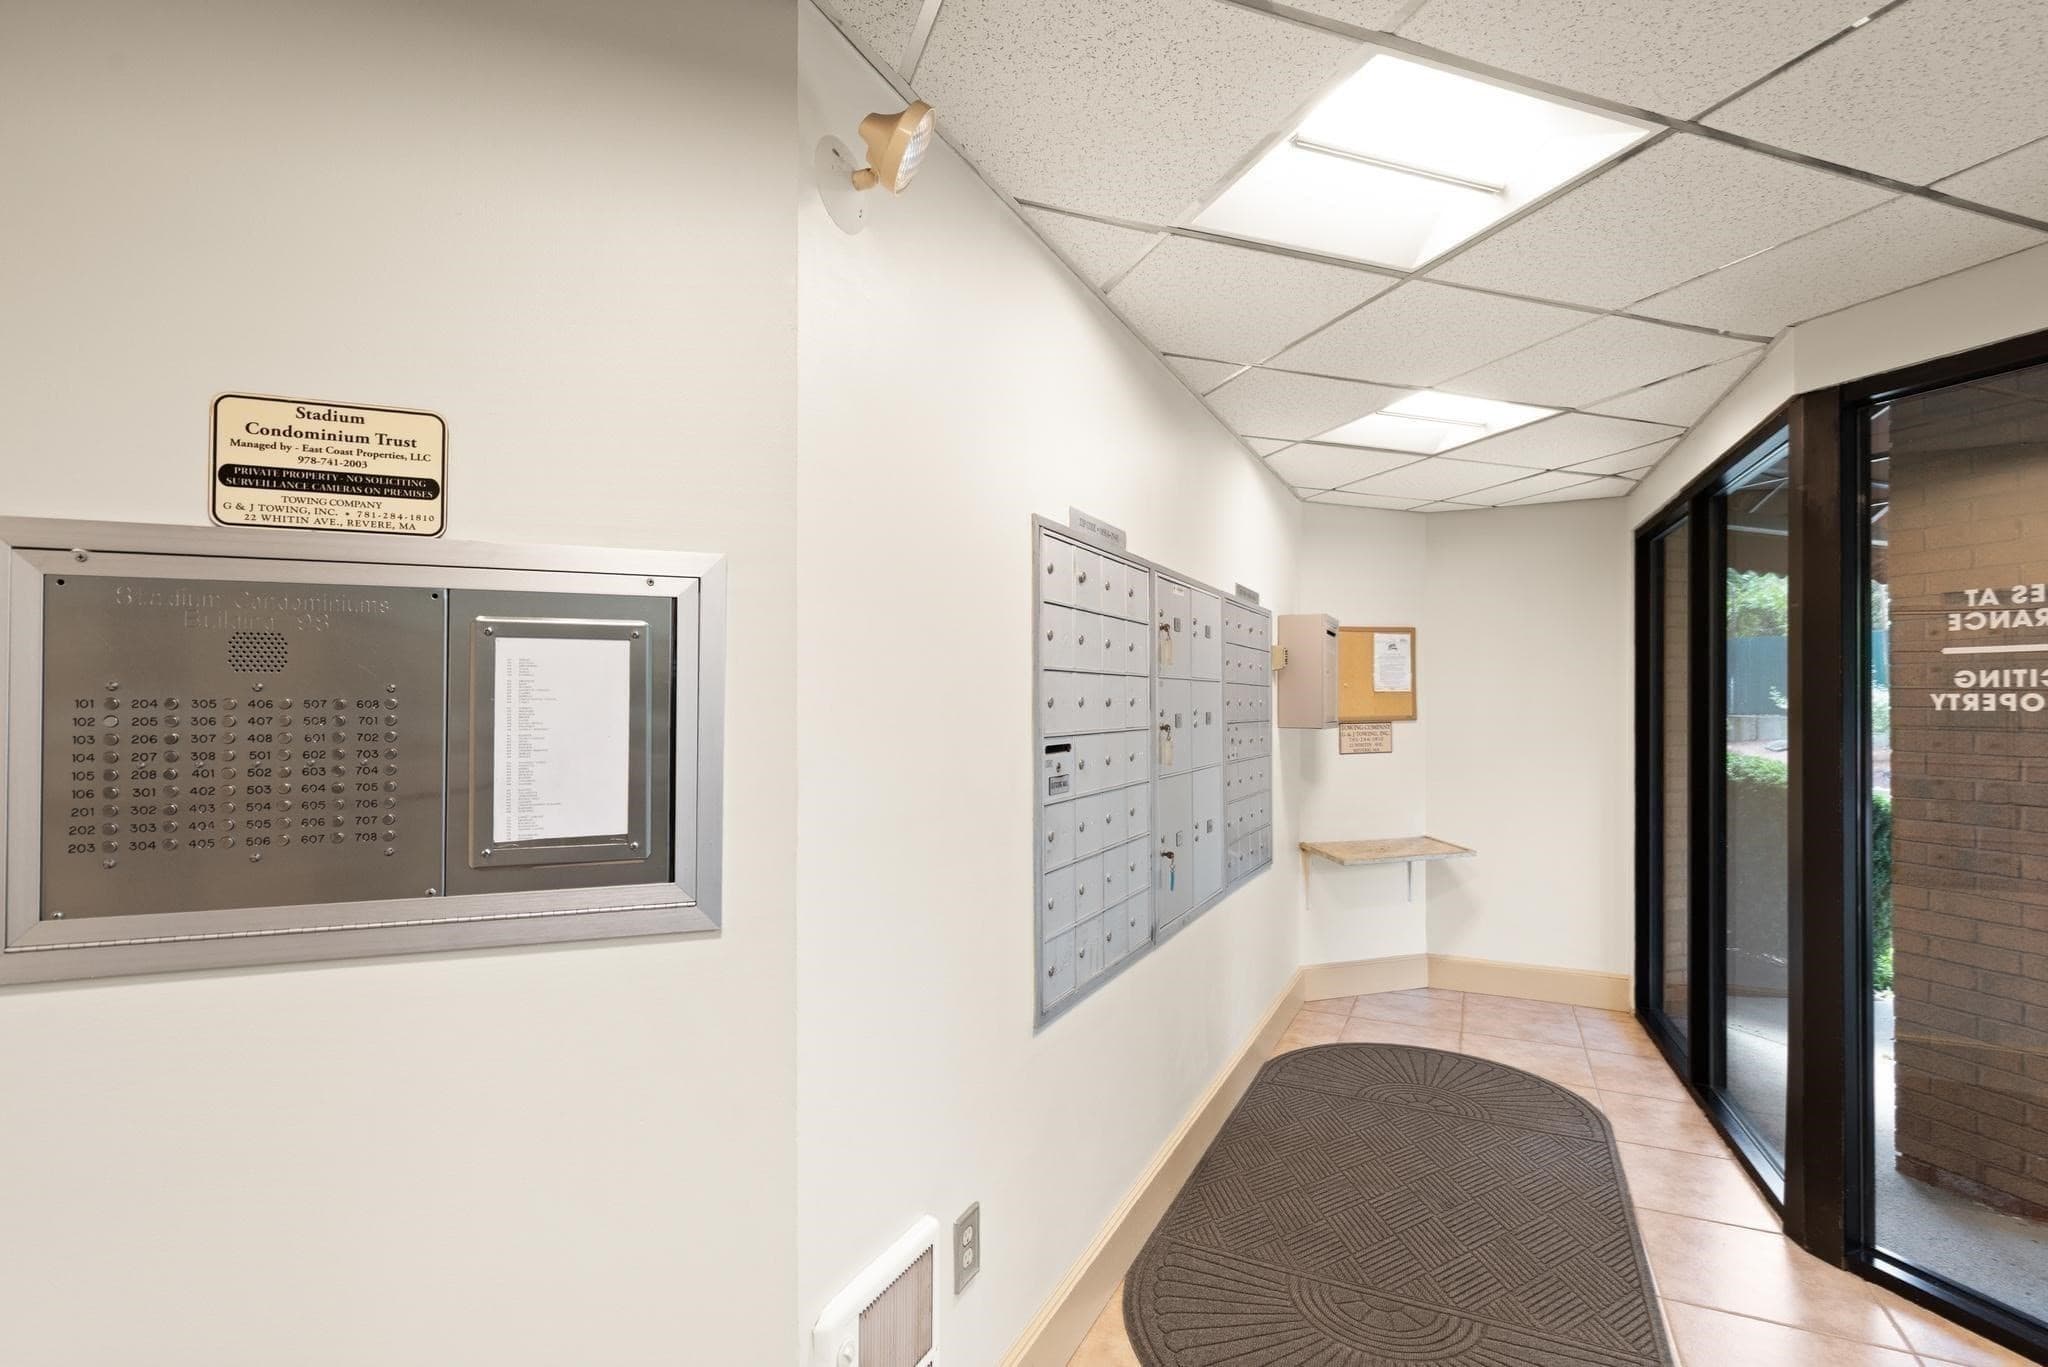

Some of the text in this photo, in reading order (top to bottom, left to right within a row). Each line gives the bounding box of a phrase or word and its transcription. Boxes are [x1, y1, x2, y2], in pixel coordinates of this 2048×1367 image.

[295, 407, 365, 425] Stadium
[245, 422, 417, 448] Condominium Trust
[230, 438, 277, 451] Managed
[280, 442, 292, 453] by
[302, 444, 323, 454] East
[326, 446, 353, 456] Coast
[356, 448, 407, 461] Properties,
[410, 453, 431, 462] LLC
[298, 456, 368, 469] 978-741-2003
[234, 467, 280, 478] PRIVATE
[282, 469, 338, 481] PROPERTY
[346, 474, 363, 483] NO
[365, 476, 426, 488] SOLICITING
[226, 477, 433, 498] SURVEILLANCE CAMERAS ON PREMISES
[281, 496, 382, 510] TOWING COMPANY
[223, 502, 435, 522] G & J TOWING, INC. 781-284-1810
[244, 513, 416, 530] 22 WHITIN AVE., REVERE, MA
[74, 698, 95, 709] 101
[131, 698, 159, 709] 204
[191, 698, 218, 709] 305
[247, 699, 274, 710] 406
[303, 699, 328, 710] 507
[356, 699, 380, 709] 608
[72, 716, 96, 727] 102
[131, 716, 159, 727] 205
[190, 716, 217, 727] 306
[247, 716, 274, 726] 407
[303, 716, 328, 726] 508
[358, 716, 378, 726] 701
[72, 734, 96, 745] 103
[130, 734, 158, 745] 206
[190, 733, 217, 744] 307
[247, 733, 273, 744] 408
[303, 733, 326, 743] 601
[356, 732, 379, 743] 702
[71, 753, 96, 764] 104
[130, 751, 158, 763] 207
[190, 751, 216, 762] 308
[248, 750, 271, 761] 501
[302, 749, 327, 760] 602
[355, 749, 380, 759] 703
[71, 770, 95, 782] 105
[130, 769, 157, 780] 208
[191, 768, 215, 779] 401
[247, 767, 273, 778] 502
[301, 766, 327, 777] 603
[355, 765, 379, 776] 704
[132, 787, 156, 798] 301
[189, 785, 216, 797] 402
[246, 784, 272, 796] 503
[300, 783, 326, 794] 604
[355, 782, 379, 792] 705
[71, 788, 95, 800] 106
[188, 803, 216, 814] 403
[245, 802, 271, 813] 504
[301, 800, 326, 811] 605
[355, 799, 379, 809] 706
[70, 807, 95, 818] 201
[130, 805, 158, 816] 302
[188, 820, 215, 831] 404
[246, 818, 272, 830] 505
[300, 817, 326, 828] 606
[354, 815, 378, 825] 707
[68, 824, 96, 837] 202
[129, 822, 157, 833] 303
[245, 836, 271, 847] 506
[300, 834, 326, 845] 607
[354, 831, 378, 842] 708
[67, 843, 96, 855] 203
[128, 840, 157, 852] 304
[188, 838, 216, 849] 405
